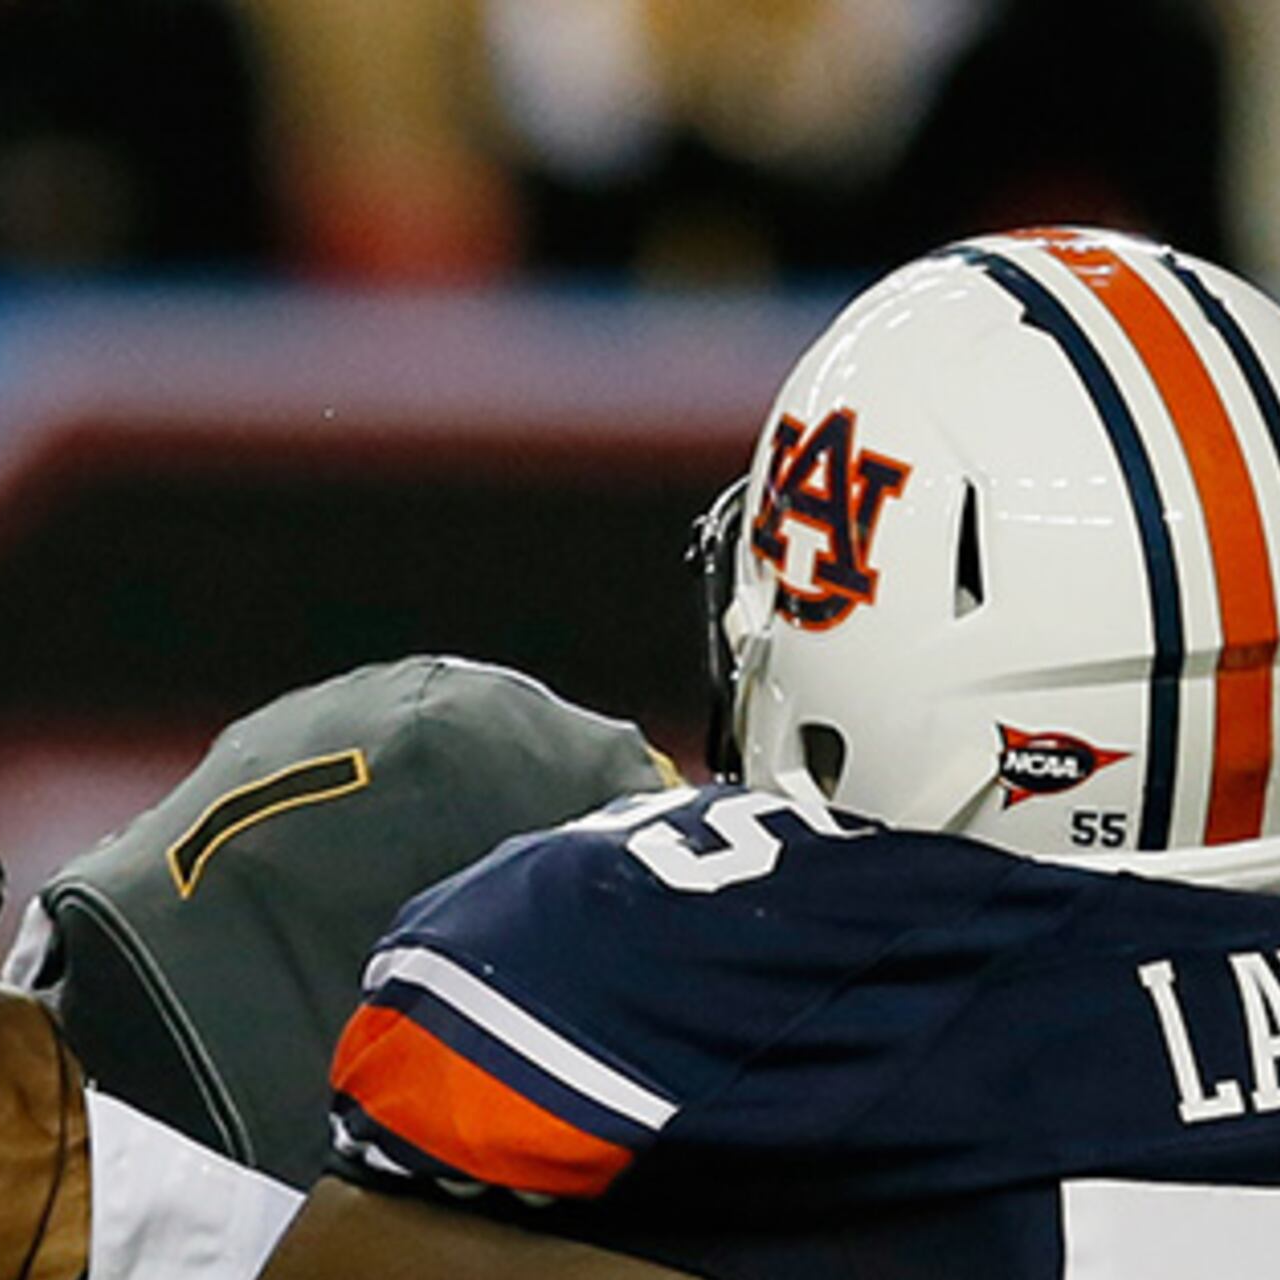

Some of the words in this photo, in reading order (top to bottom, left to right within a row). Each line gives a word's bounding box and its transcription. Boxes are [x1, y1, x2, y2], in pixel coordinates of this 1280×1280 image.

[1004, 750, 1082, 779] NCAA
[166, 747, 372, 900] 1
[1071, 809, 1128, 848] 55
